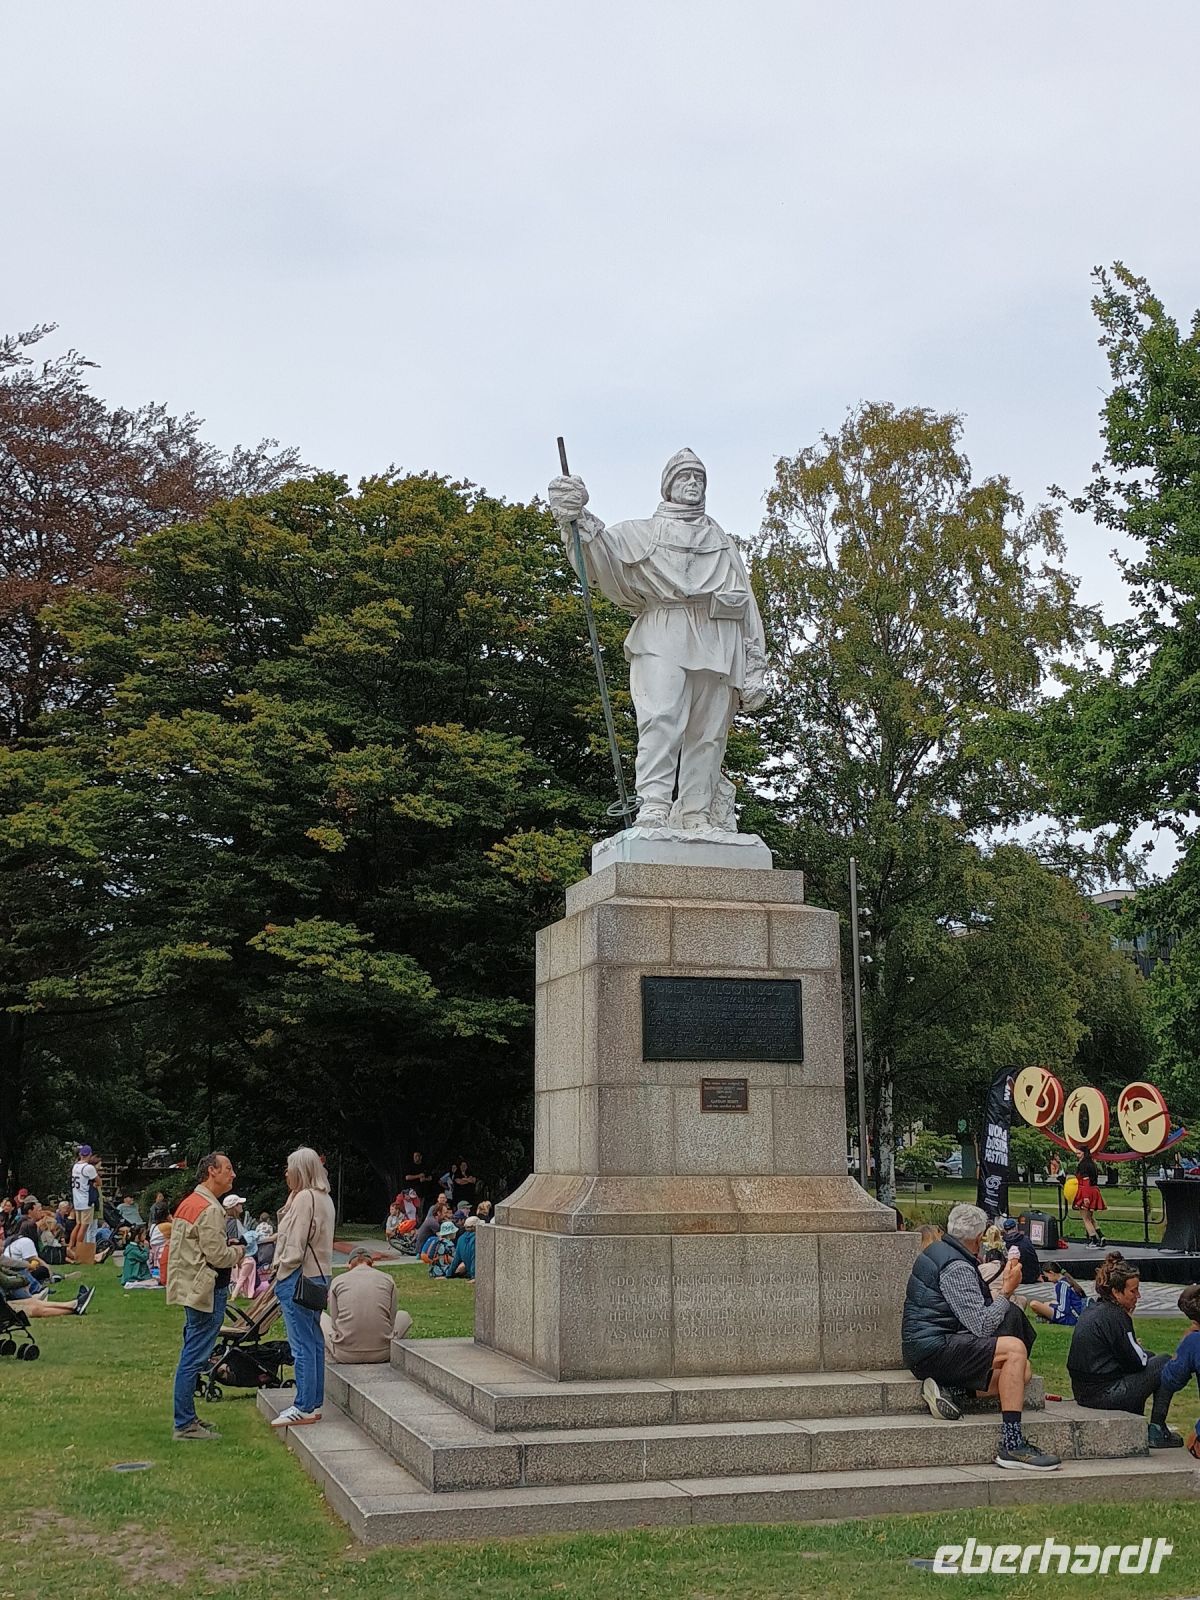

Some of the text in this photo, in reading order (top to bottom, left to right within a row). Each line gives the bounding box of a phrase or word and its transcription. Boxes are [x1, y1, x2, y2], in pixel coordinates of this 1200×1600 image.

[617, 1276, 635, 1287] DO
[642, 1275, 666, 1288] NOT
[720, 1273, 745, 1286] THIS
[609, 1310, 640, 1322] HELP
[633, 1327, 671, 1339] GREAT
